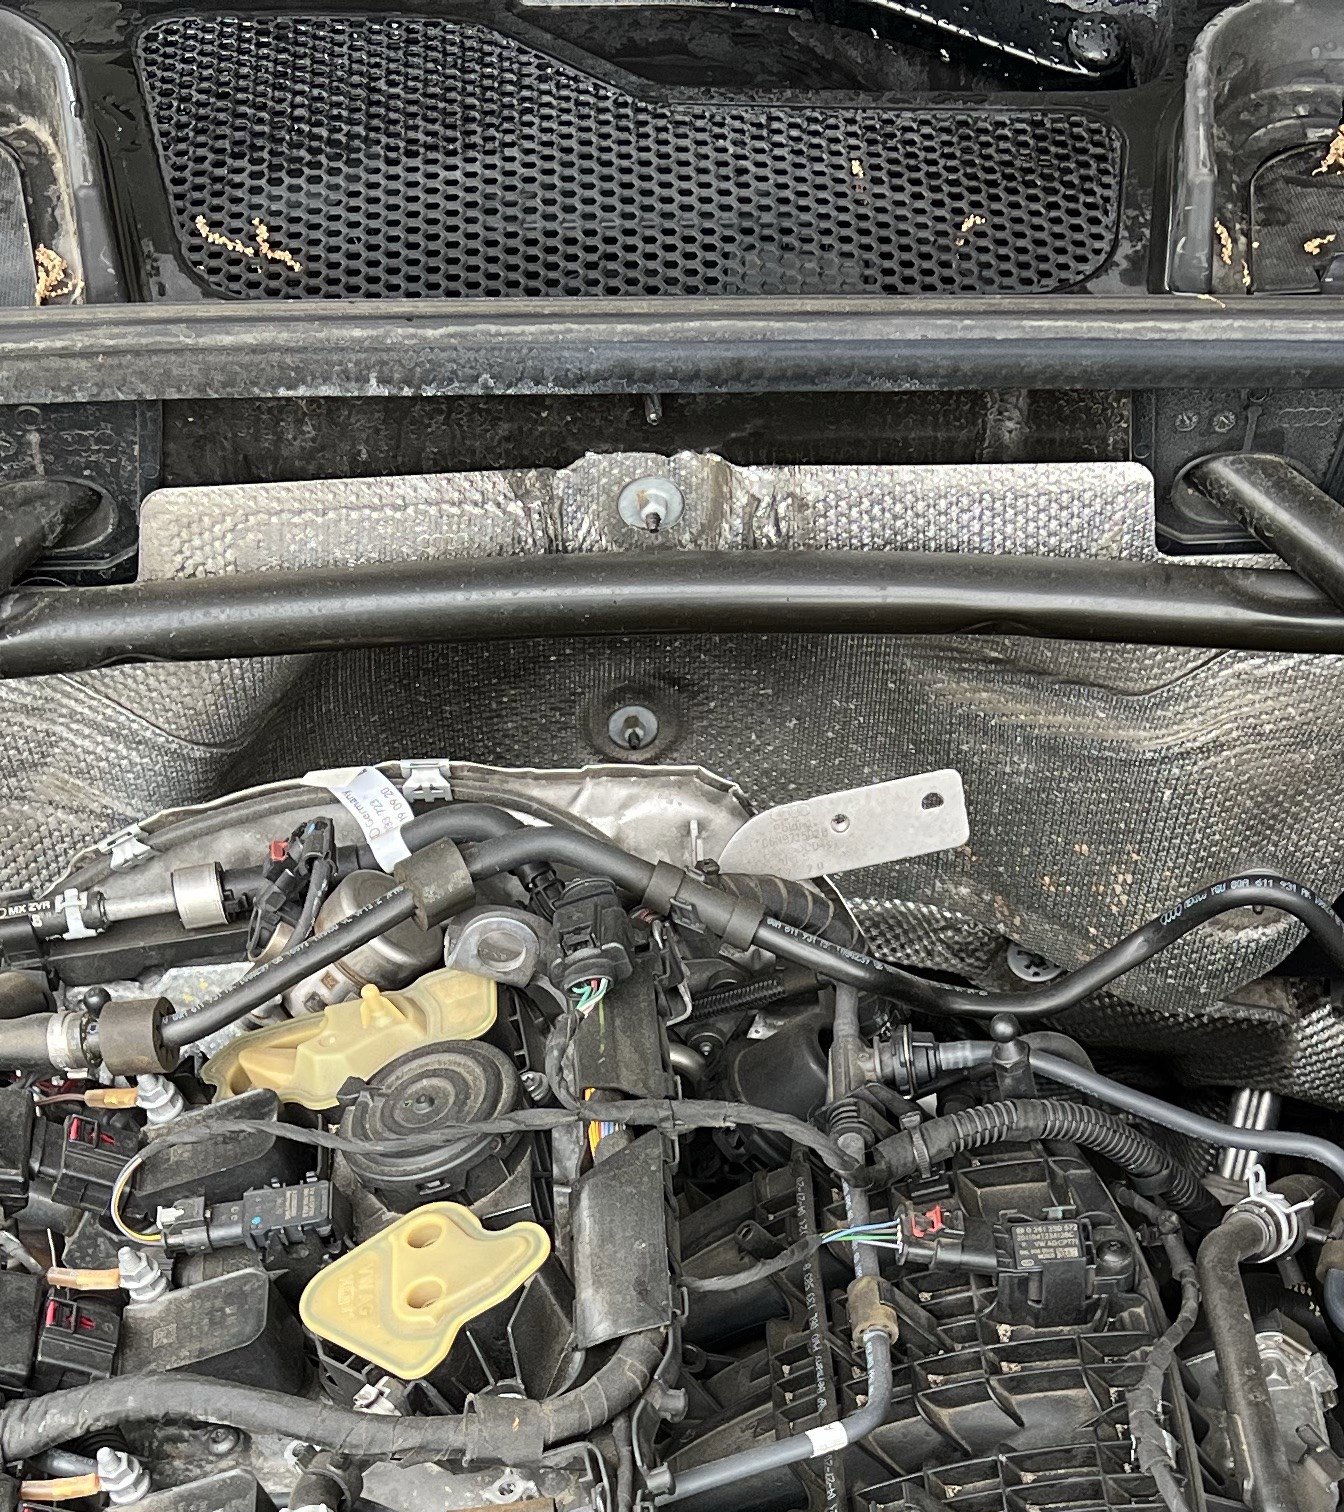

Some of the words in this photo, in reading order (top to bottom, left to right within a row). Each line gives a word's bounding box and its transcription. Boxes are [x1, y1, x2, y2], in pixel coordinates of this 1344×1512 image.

[342, 790, 373, 828] Germany
[9, 904, 26, 915] MX
[28, 901, 51, 912] ZVR
